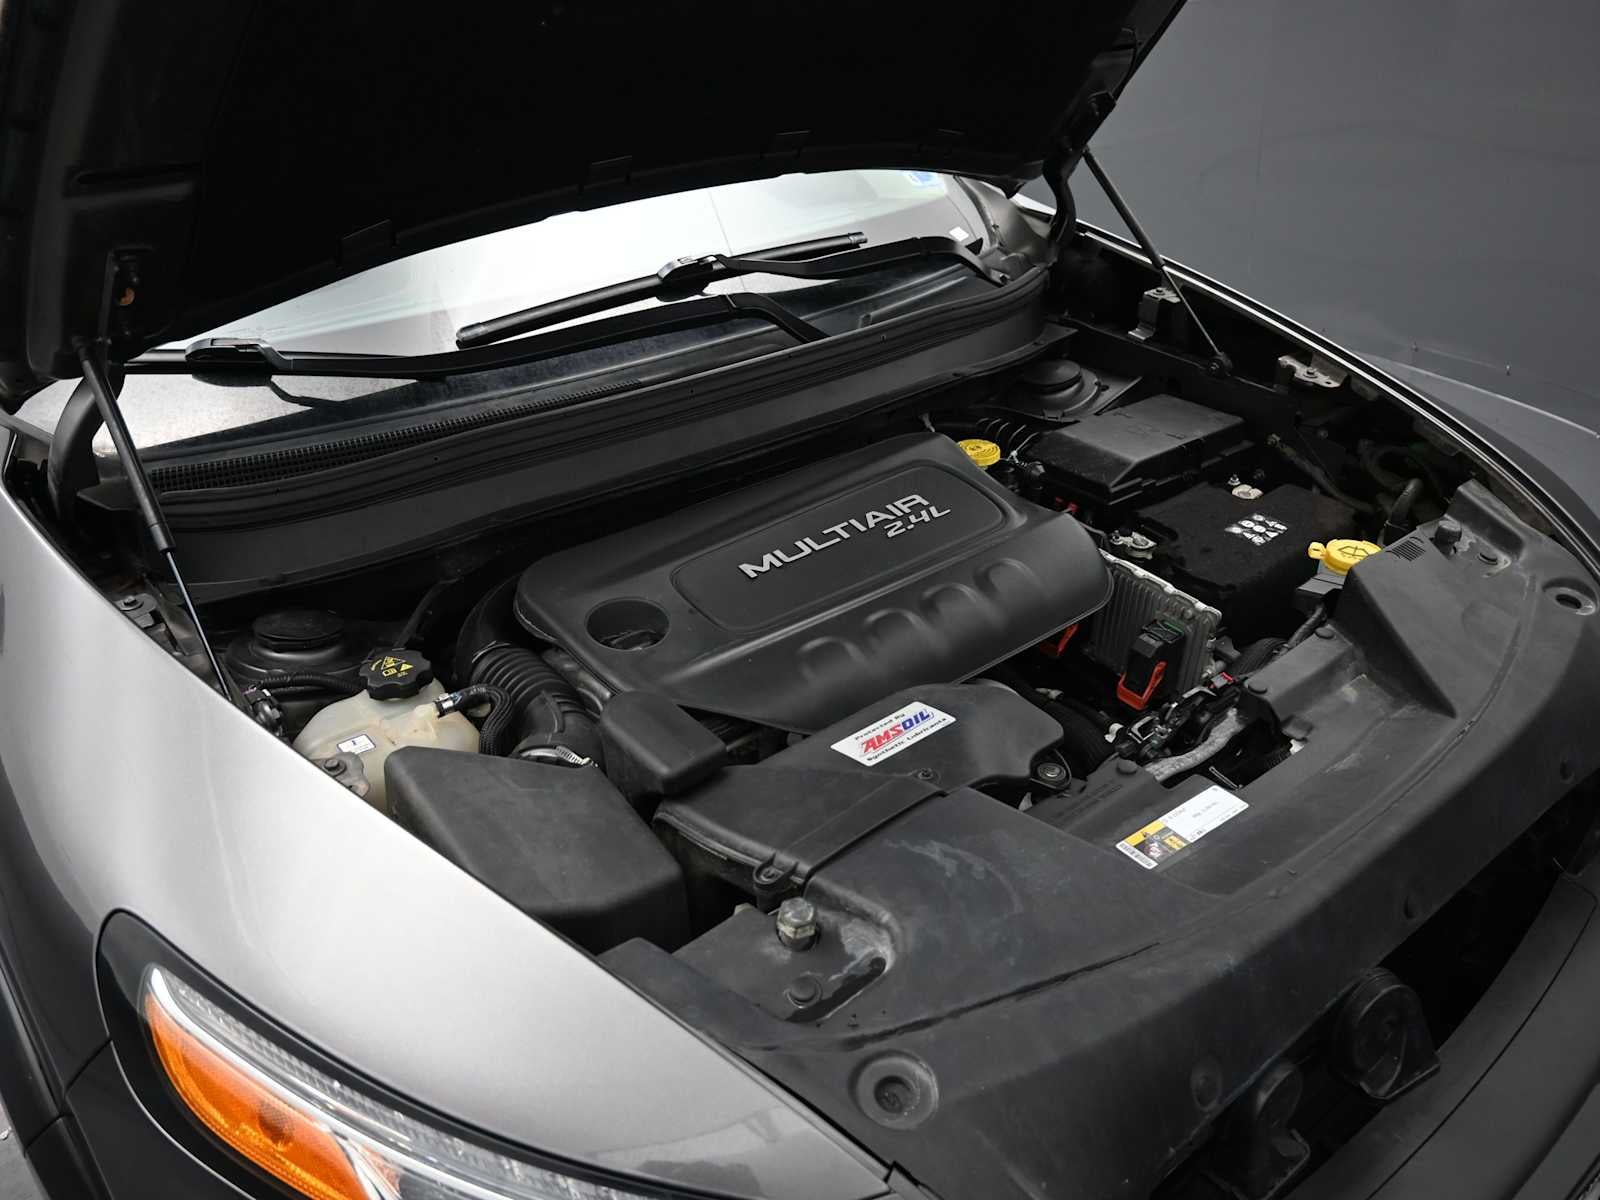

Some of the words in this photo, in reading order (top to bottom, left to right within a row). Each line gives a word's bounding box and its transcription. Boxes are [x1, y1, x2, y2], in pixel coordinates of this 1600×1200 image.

[738, 494, 930, 578] MULTIAIR
[884, 506, 951, 538] 2.4L
[862, 710, 931, 754] AMSOIL
